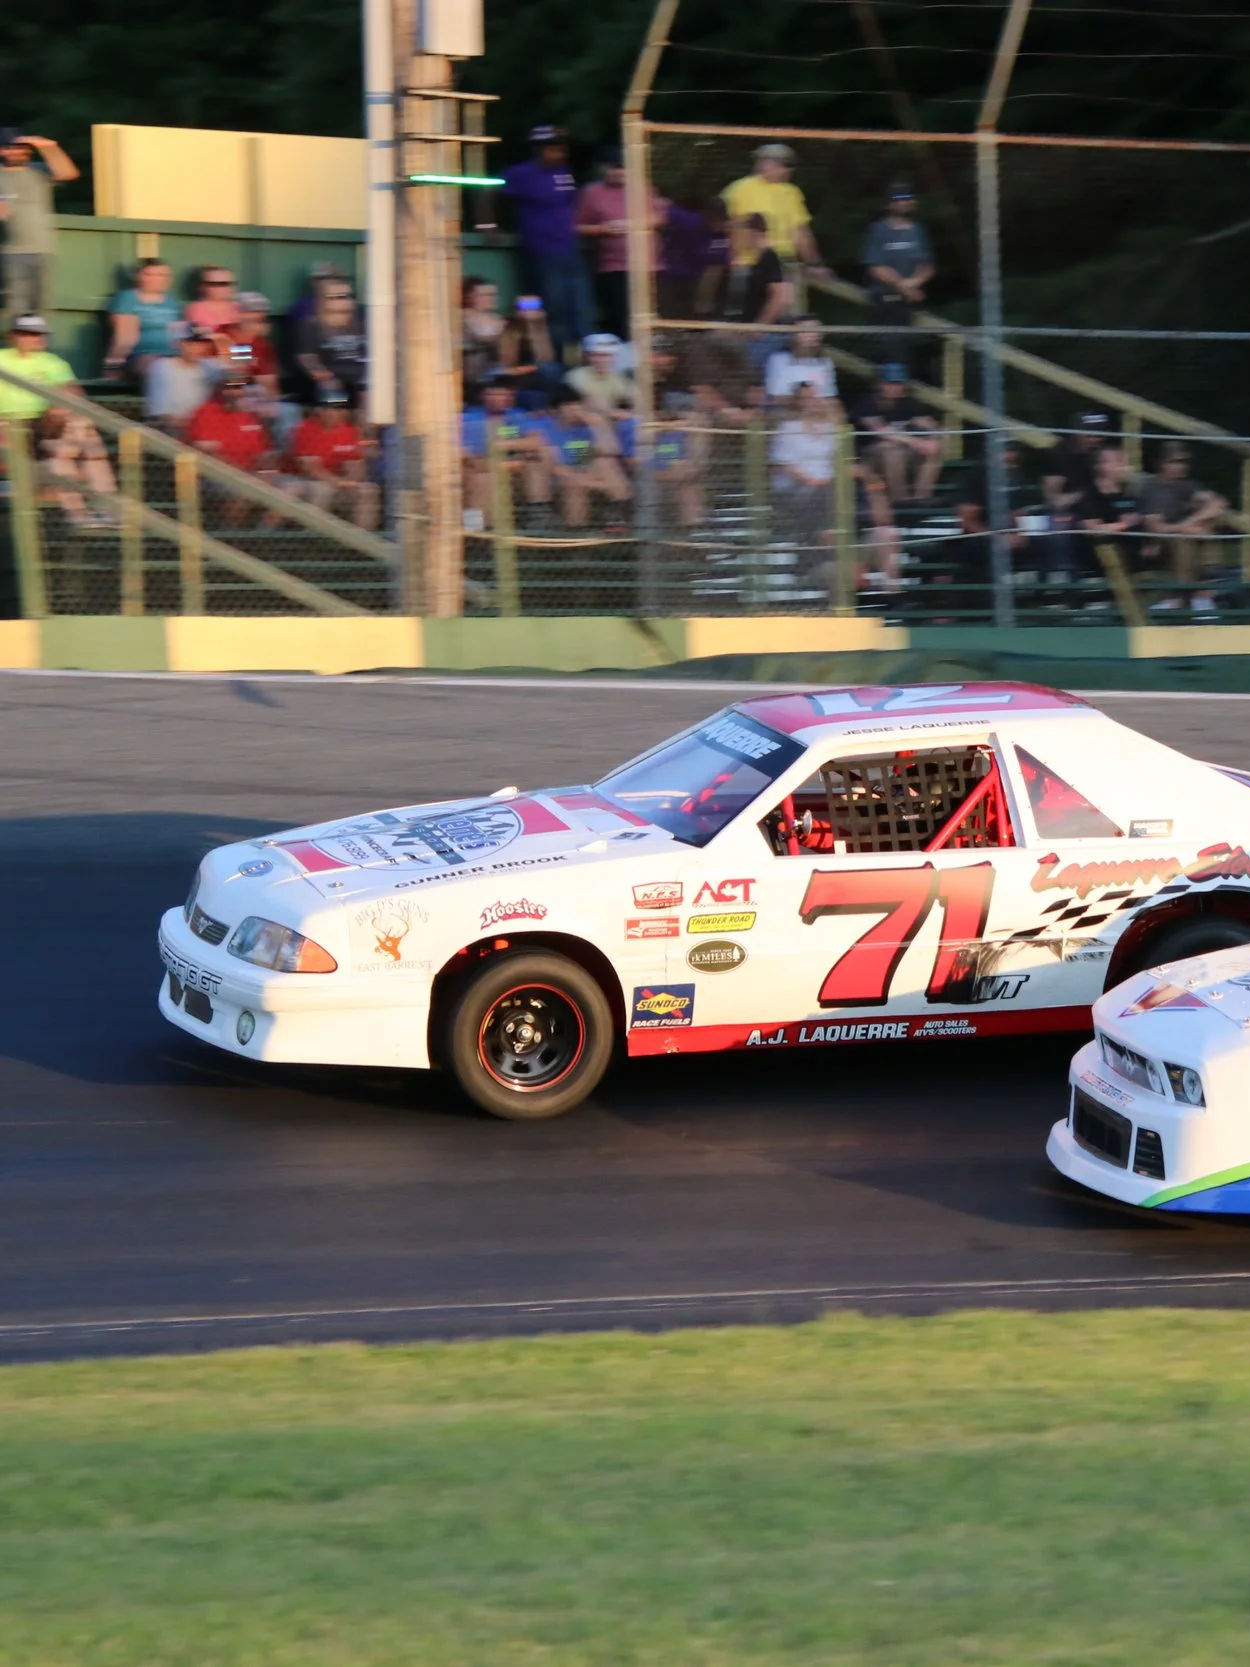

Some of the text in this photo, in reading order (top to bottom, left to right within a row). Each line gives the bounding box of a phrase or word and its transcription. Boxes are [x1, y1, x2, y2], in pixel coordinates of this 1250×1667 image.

[842, 719, 992, 737] JESSE LAQUERRE
[394, 854, 568, 889] GUNNER BROOK
[692, 878, 757, 904] ACT
[354, 905, 373, 927] BIG
[397, 898, 431, 924] GUNS
[480, 898, 548, 931] Hoosier
[691, 915, 751, 926] THUNDER ROAD
[799, 860, 996, 1008] 71
[691, 952, 732, 962] rk MILES
[357, 962, 381, 972] EAST
[638, 998, 687, 1010] SUNOCO
[632, 1017, 691, 1028] RACE FUELS
[923, 1019, 969, 1028] AUTO SALES
[746, 1022, 910, 1046] A.J. LAQUERRE
[913, 1026, 977, 1038] ATV'S/SCOOTERS
